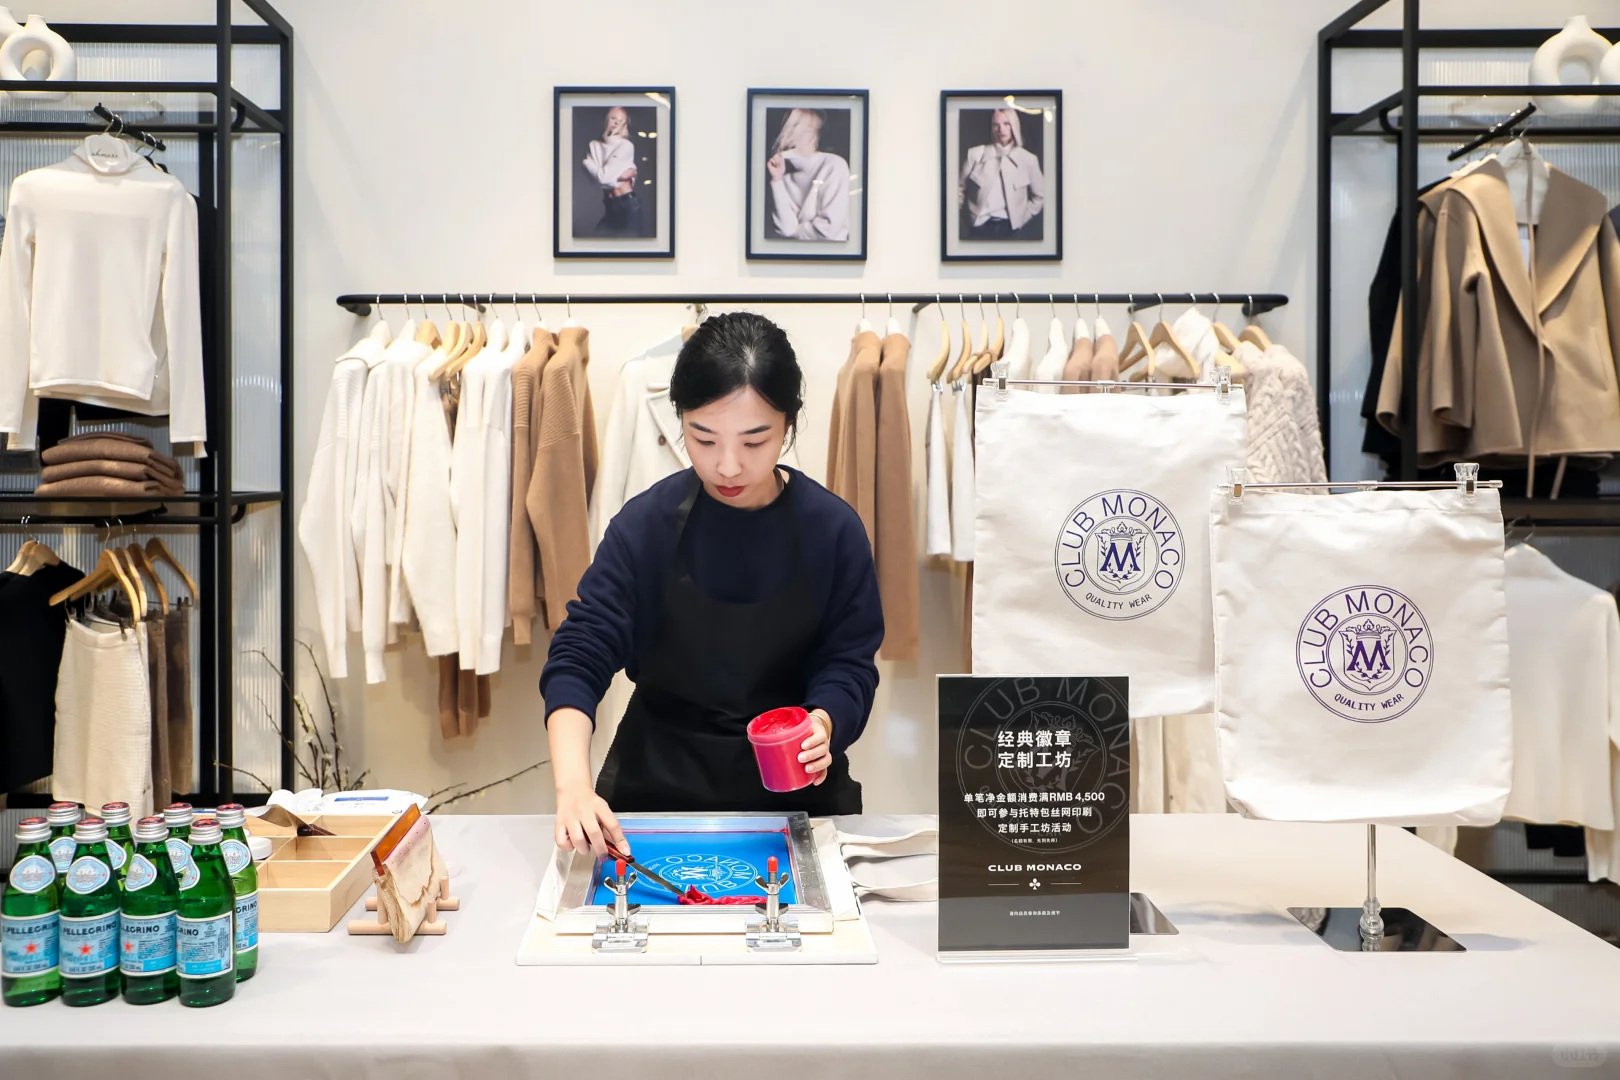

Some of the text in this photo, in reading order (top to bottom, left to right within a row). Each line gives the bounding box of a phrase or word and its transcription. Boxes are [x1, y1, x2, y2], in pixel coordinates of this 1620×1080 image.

[1061, 494, 1180, 589] CLUB MONACO
[1085, 592, 1152, 609] QUALITY WEAR
[1303, 590, 1429, 688] CLUB MONACO
[1333, 693, 1405, 711] QUALITY WEAR
[964, 677, 1040, 770] CLUB
[997, 730, 1072, 748] 经典徽章
[997, 751, 1072, 769] 定制工坊
[964, 792, 1106, 803] 单笔净金额消费满RMB 4,500
[976, 807, 1093, 819] 即可参与托特包丝网印刷
[997, 822, 1072, 834] 定制手工坊活动
[987, 863, 1082, 872] CLUB MONACO
